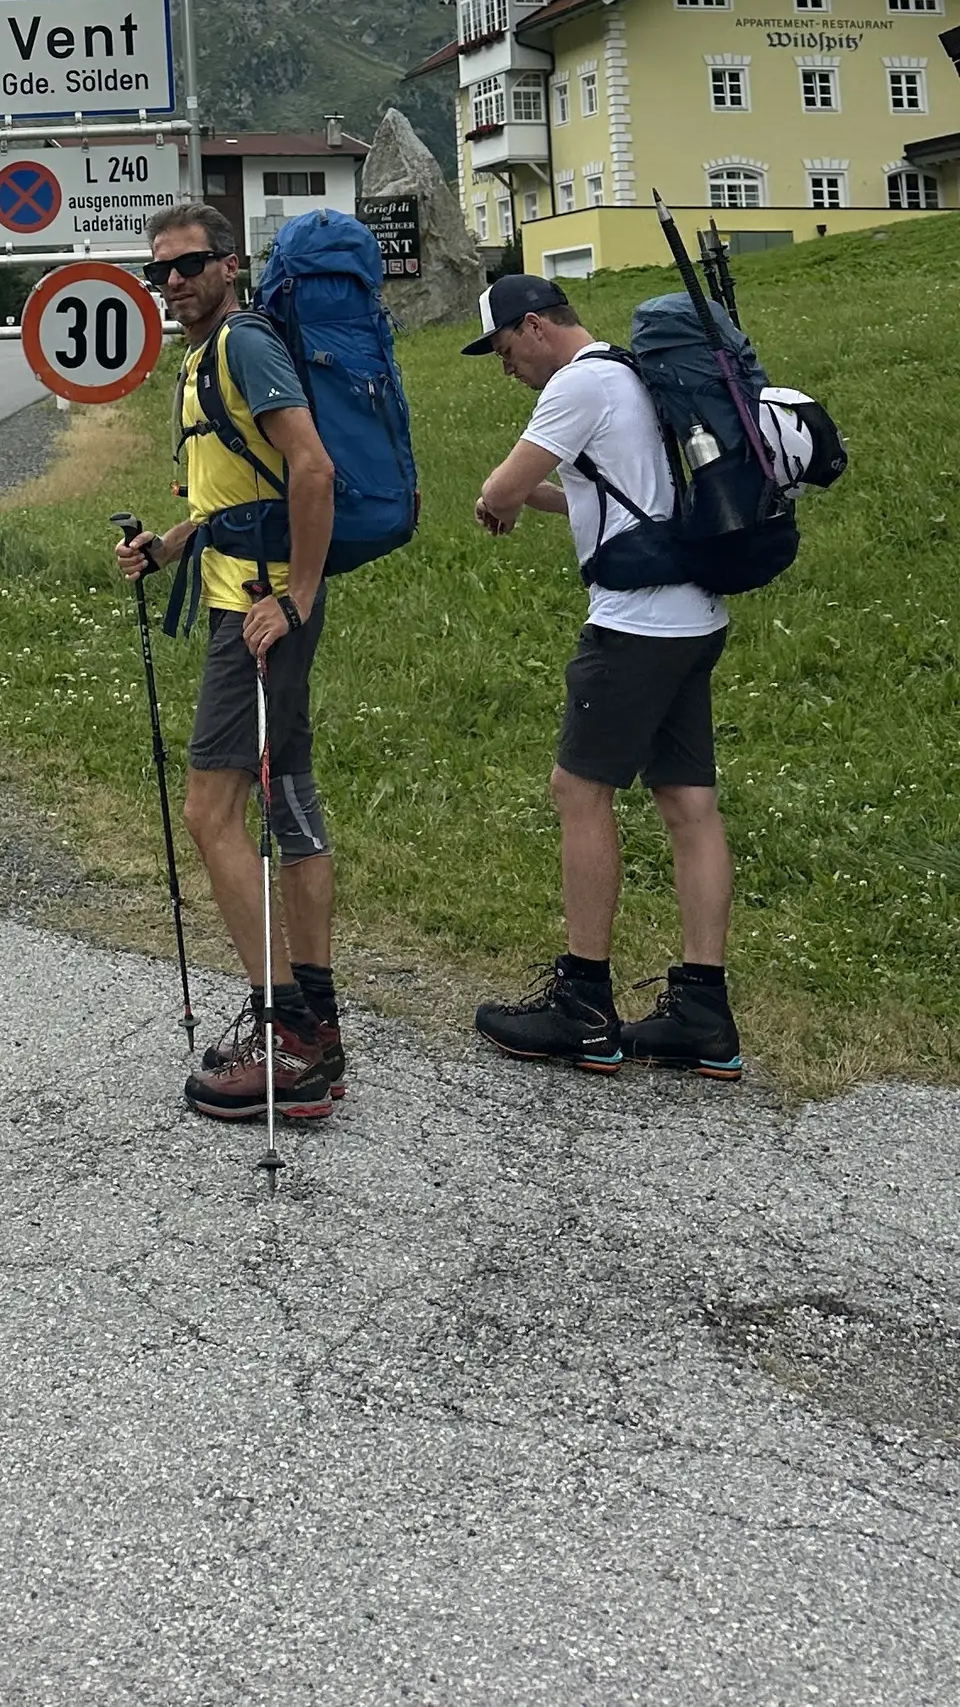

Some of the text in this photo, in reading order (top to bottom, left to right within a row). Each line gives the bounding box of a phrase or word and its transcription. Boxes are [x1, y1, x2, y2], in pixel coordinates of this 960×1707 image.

[7, 13, 138, 61] Vent
[2, 69, 149, 96] Gde. Sölden
[85, 155, 149, 184] L 240
[68, 193, 174, 213] ausgenommen
[364, 201, 410, 216] Grieß di
[366, 221, 415, 231] RGSTEIGER
[376, 231, 399, 240] DORF
[377, 239, 413, 254] ENT
[55, 296, 128, 370] 30
